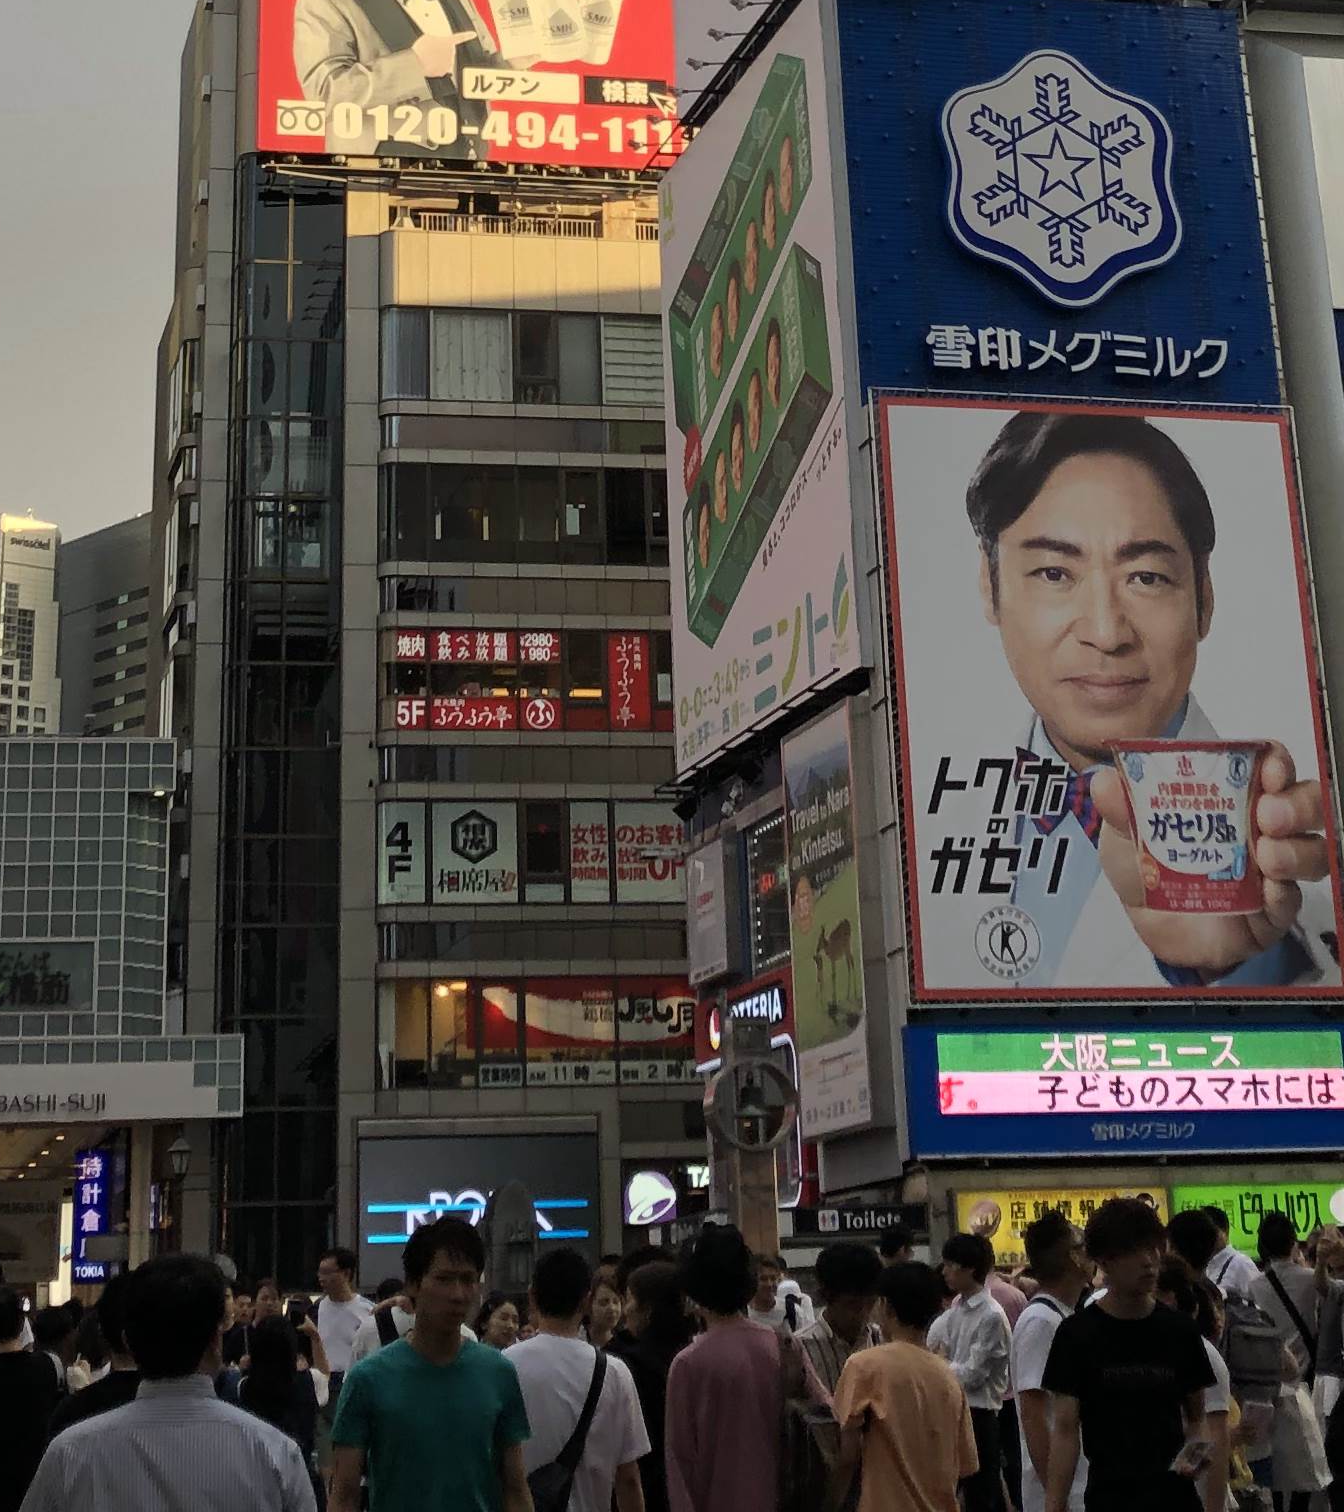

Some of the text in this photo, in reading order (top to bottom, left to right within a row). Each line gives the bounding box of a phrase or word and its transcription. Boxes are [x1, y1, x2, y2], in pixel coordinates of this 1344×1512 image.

[471, 73, 541, 96] ルアン
[925, 324, 1230, 381] 雪印メグミルク
[396, 699, 427, 727] 5F
[927, 755, 1072, 820] トクホ
[789, 796, 820, 835] Travel
[826, 785, 850, 815] Nara
[985, 816, 1010, 837] の
[928, 833, 1072, 897] ガセリ
[729, 986, 784, 1024] TTERIA
[1040, 1033, 1242, 1073] 大阪ニュース
[1037, 1073, 1336, 1112] 子どものスマホには
[1090, 1121, 1196, 1143] 雪印メグミルク
[77, 1155, 104, 1258] 時計倉
[1238, 1190, 1324, 1245] ピタトハウス
[74, 1265, 106, 1279] TOKIA
